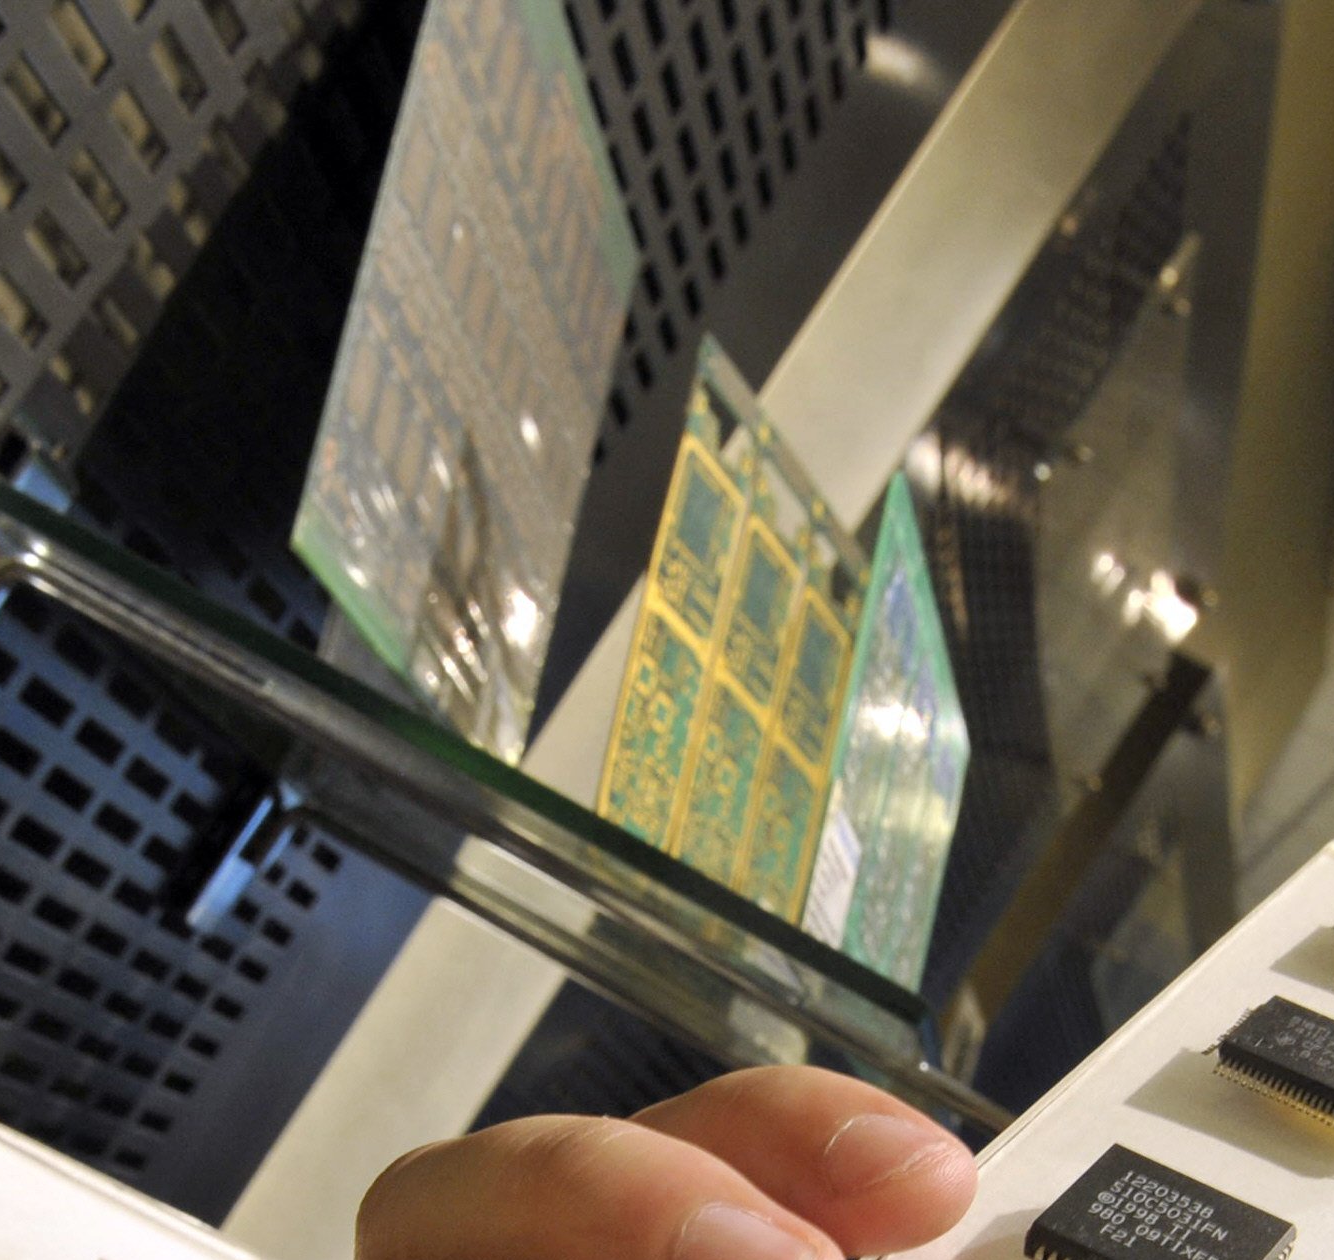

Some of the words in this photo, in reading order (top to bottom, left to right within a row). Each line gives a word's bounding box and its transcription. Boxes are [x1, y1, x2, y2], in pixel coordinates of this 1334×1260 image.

[1120, 1170, 1215, 1220] 12203538
[1087, 1201, 1126, 1226] 980
[1099, 1223, 1138, 1249] F21
